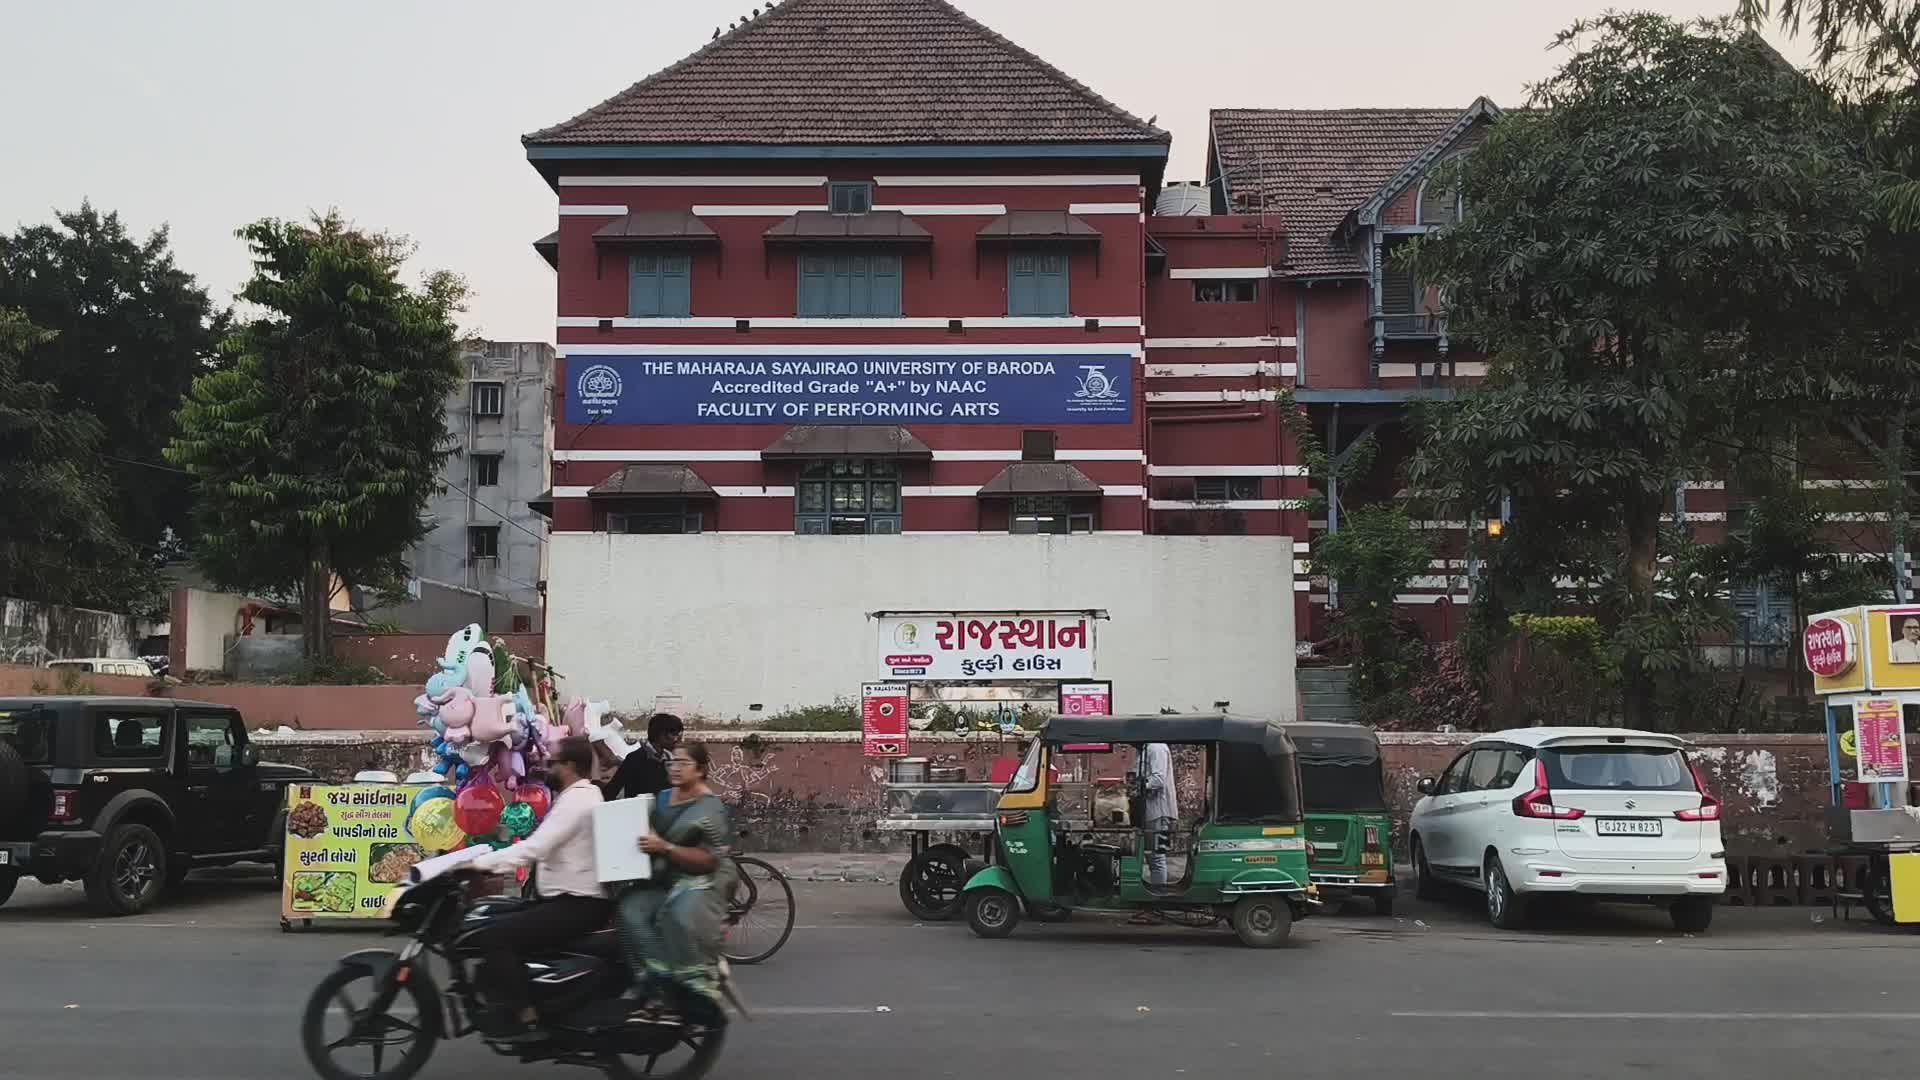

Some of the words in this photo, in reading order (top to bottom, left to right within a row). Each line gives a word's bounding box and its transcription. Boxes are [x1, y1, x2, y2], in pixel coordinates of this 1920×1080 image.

[642, 361, 674, 375] THE
[677, 361, 767, 375] MAHARAJA
[771, 361, 859, 375] SAYAJIRAO
[863, 361, 959, 375] UNIVERSITY
[961, 361, 983, 375] OF
[987, 361, 1056, 375] BARODA
[711, 380, 802, 394] Accredited
[807, 380, 860, 394] Grade
[910, 380, 930, 396] by
[935, 380, 987, 394] NAAC
[697, 402, 776, 417] FACULTY
[783, 402, 809, 417] OF
[814, 402, 944, 417] PERFORMING
[950, 402, 1000, 417] ARTS
[934, 618, 1087, 650] રાજસ્થાન
[960, 653, 1003, 676] કુલ્ફી
[1012, 653, 1062, 672] હાઉસ
[327, 791, 350, 805] જય
[332, 823, 376, 838] પાપડીનો
[378, 823, 398, 838] લોટ
[299, 848, 328, 866] સુરતી
